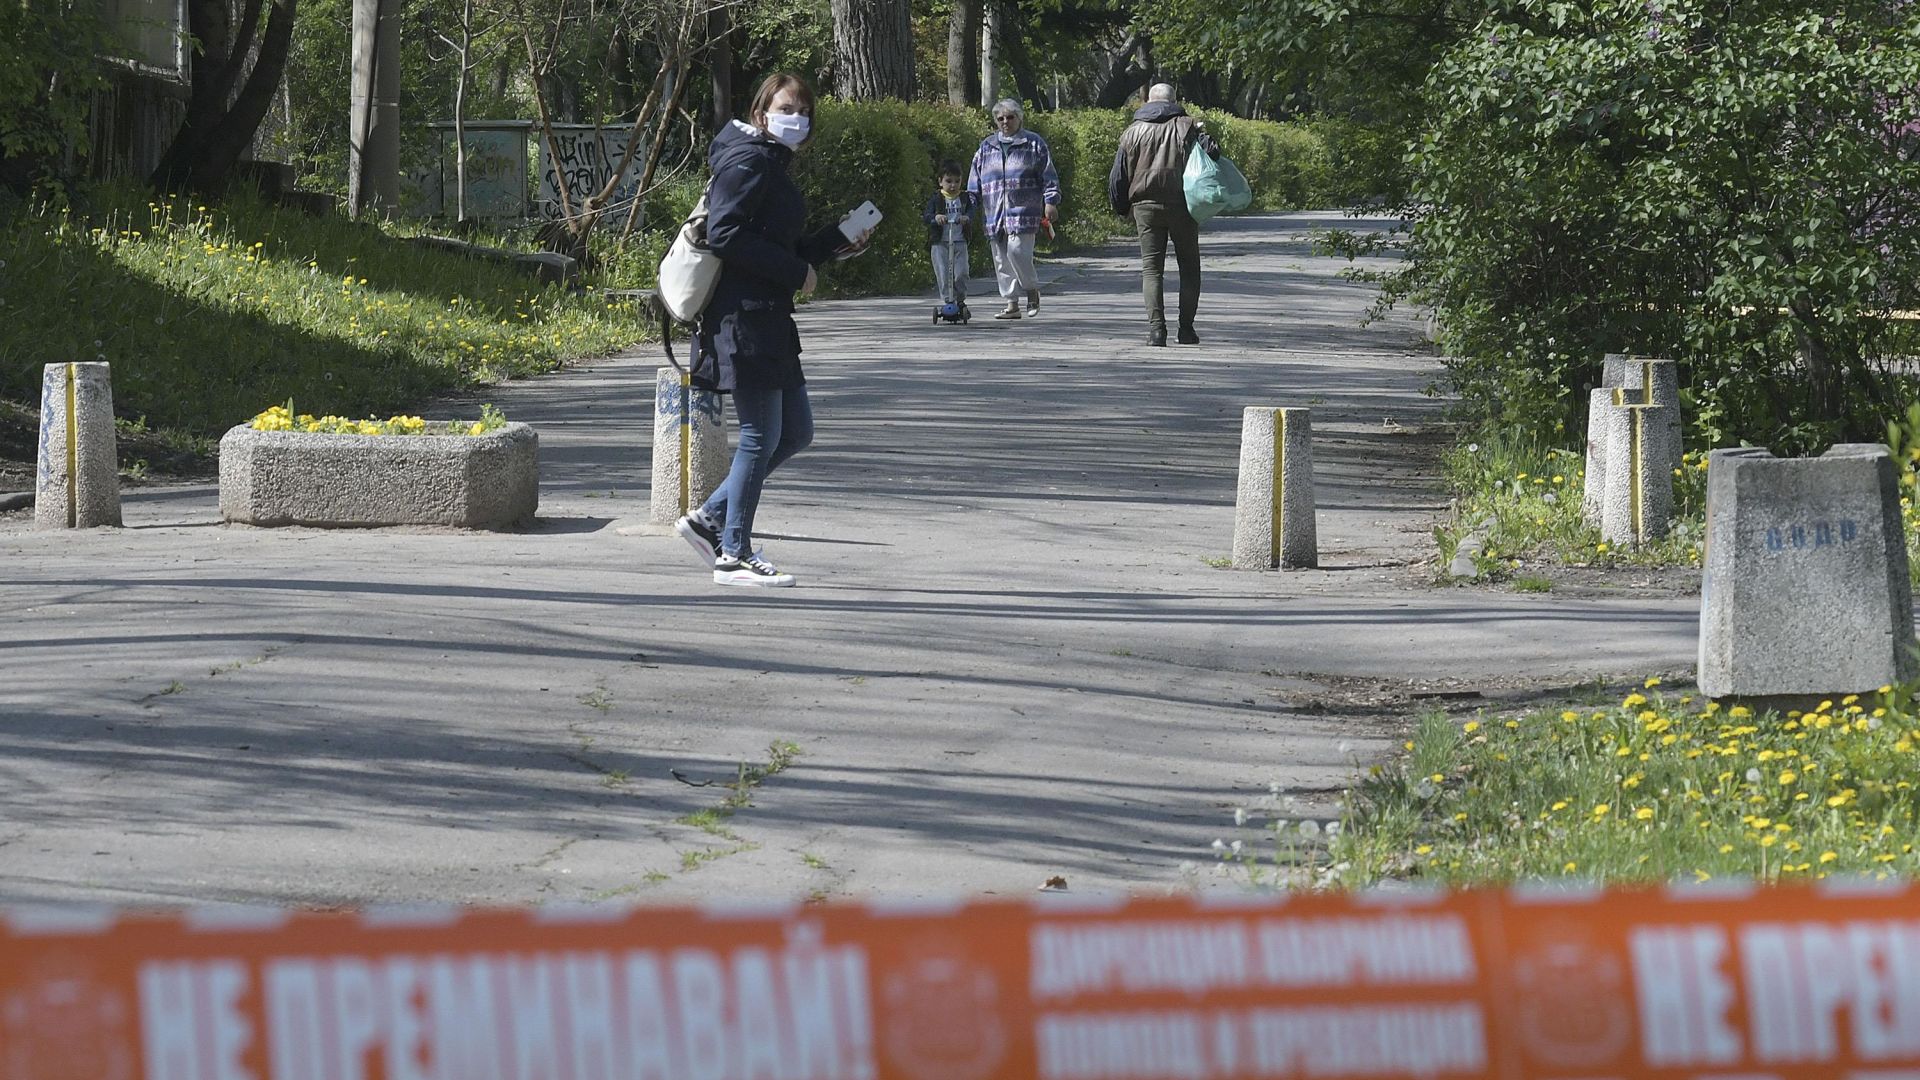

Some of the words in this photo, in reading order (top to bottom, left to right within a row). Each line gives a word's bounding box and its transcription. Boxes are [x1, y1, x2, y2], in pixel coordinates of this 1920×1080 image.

[138, 958, 254, 1080] НЕ
[262, 918, 875, 1080] ПРЕМИНАВАЙ!
[1627, 922, 1742, 1068] НЕ
